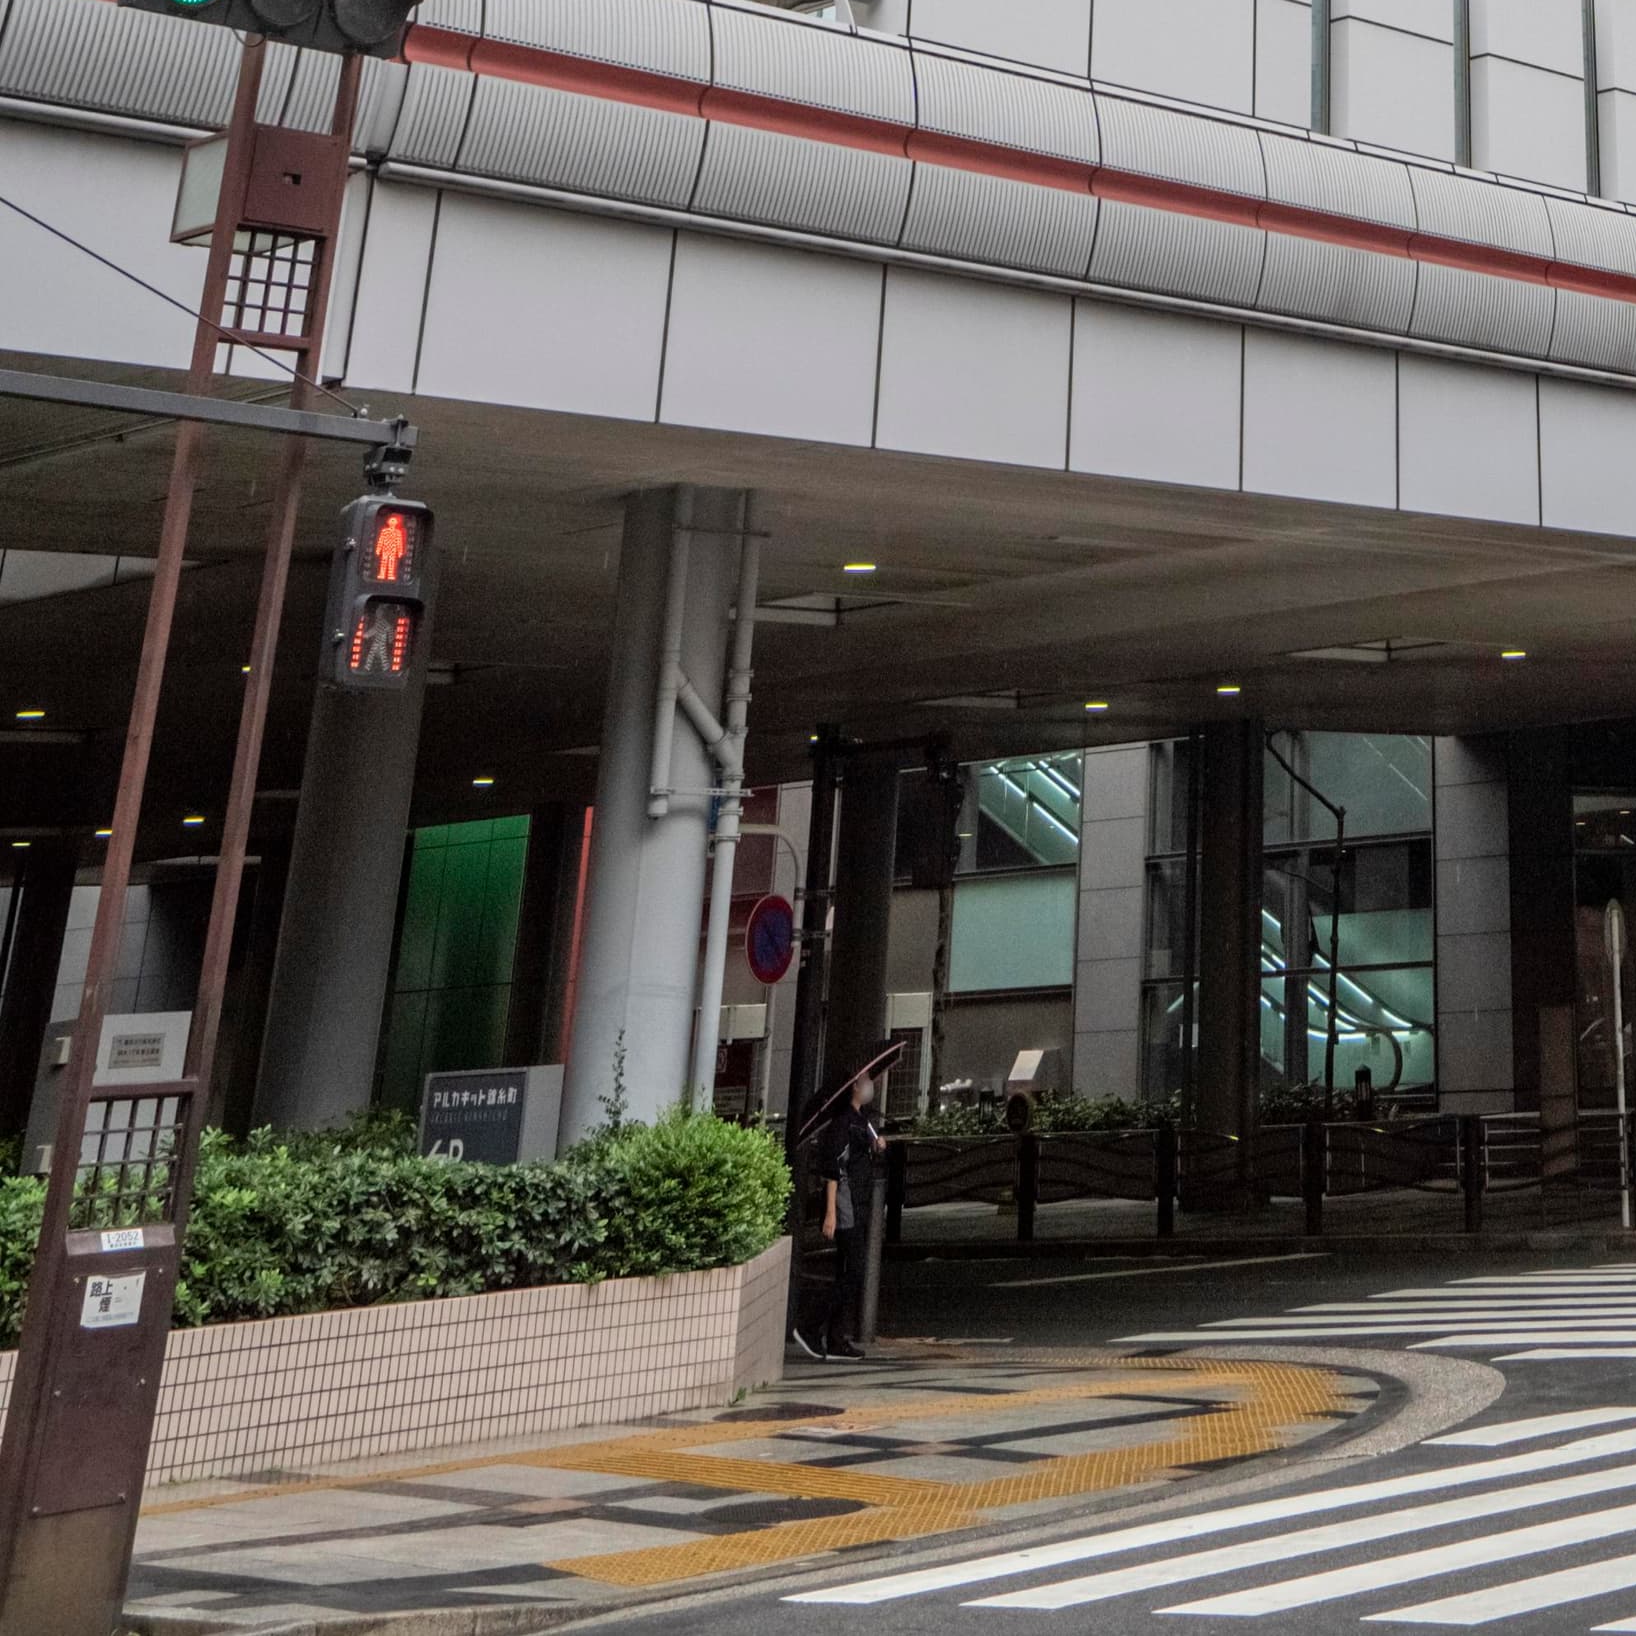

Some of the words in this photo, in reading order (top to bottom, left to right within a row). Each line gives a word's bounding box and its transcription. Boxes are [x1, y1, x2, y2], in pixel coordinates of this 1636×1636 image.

[433, 1086, 518, 1108] アルカキット錦糸町
